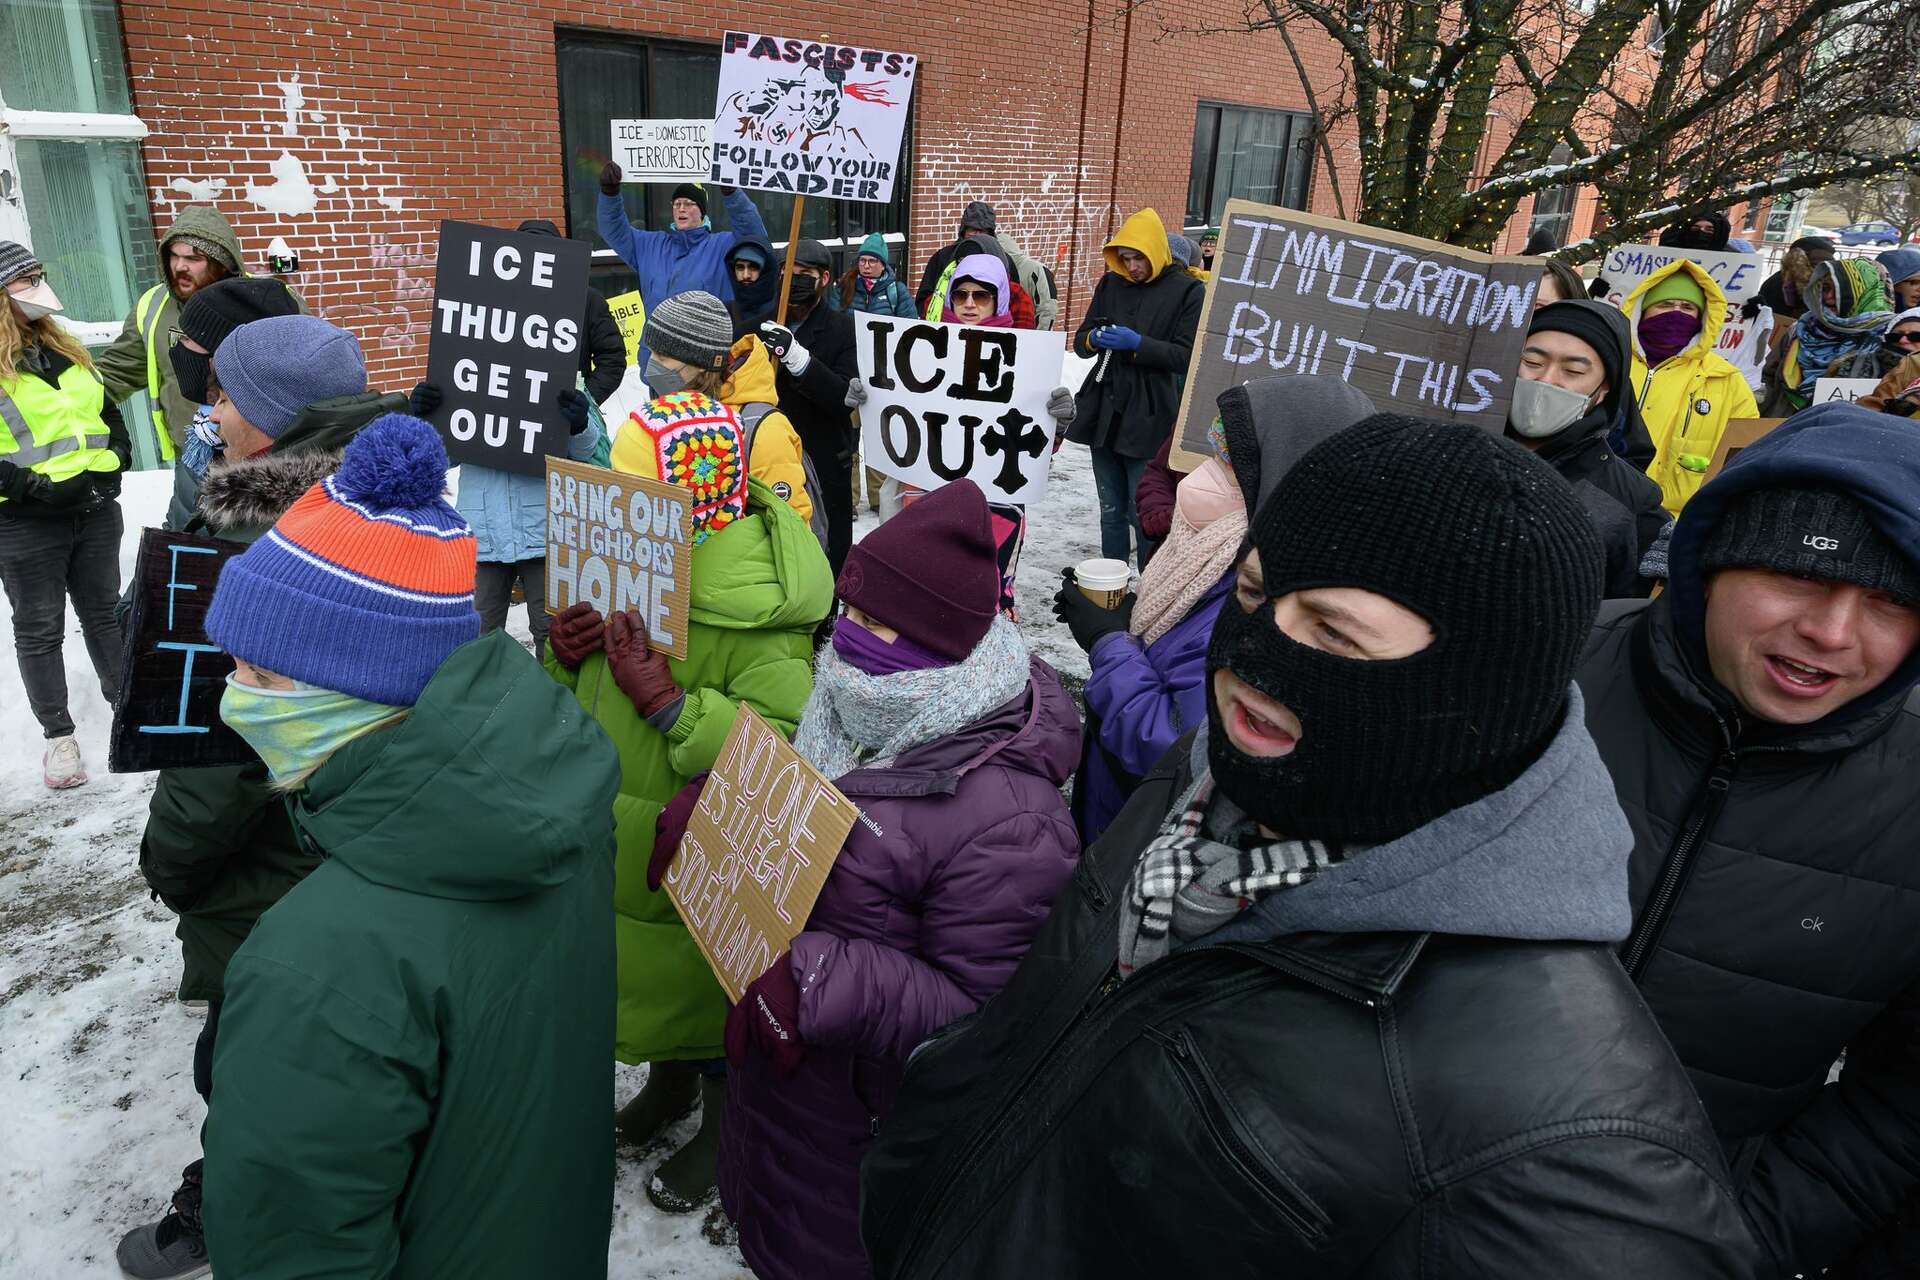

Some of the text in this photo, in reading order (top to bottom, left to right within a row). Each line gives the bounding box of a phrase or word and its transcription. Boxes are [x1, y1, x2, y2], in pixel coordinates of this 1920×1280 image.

[724, 32, 914, 78] FASCISTS:
[619, 126, 644, 140] ICE
[656, 126, 706, 142] DOMESTIC
[624, 146, 710, 171] TERRORISTS
[711, 164, 880, 200] LEADER
[713, 142, 891, 181] FOLLOW YOUR
[469, 241, 555, 288] ICE
[438, 299, 578, 353] THUGS
[453, 359, 549, 404] GET
[867, 321, 1017, 403] ICE
[1384, 352, 1503, 413] THIS
[450, 408, 543, 454] OUT
[549, 471, 684, 543] BRING OUR
[549, 512, 675, 575] NEIGHBORS
[1803, 535, 1840, 550] UGG
[549, 543, 675, 646] HOME
[724, 714, 839, 867] NO ONE
[699, 770, 793, 924] IS ILLEGAL
[667, 831, 731, 945] STOLEN
[718, 853, 746, 895] ON
